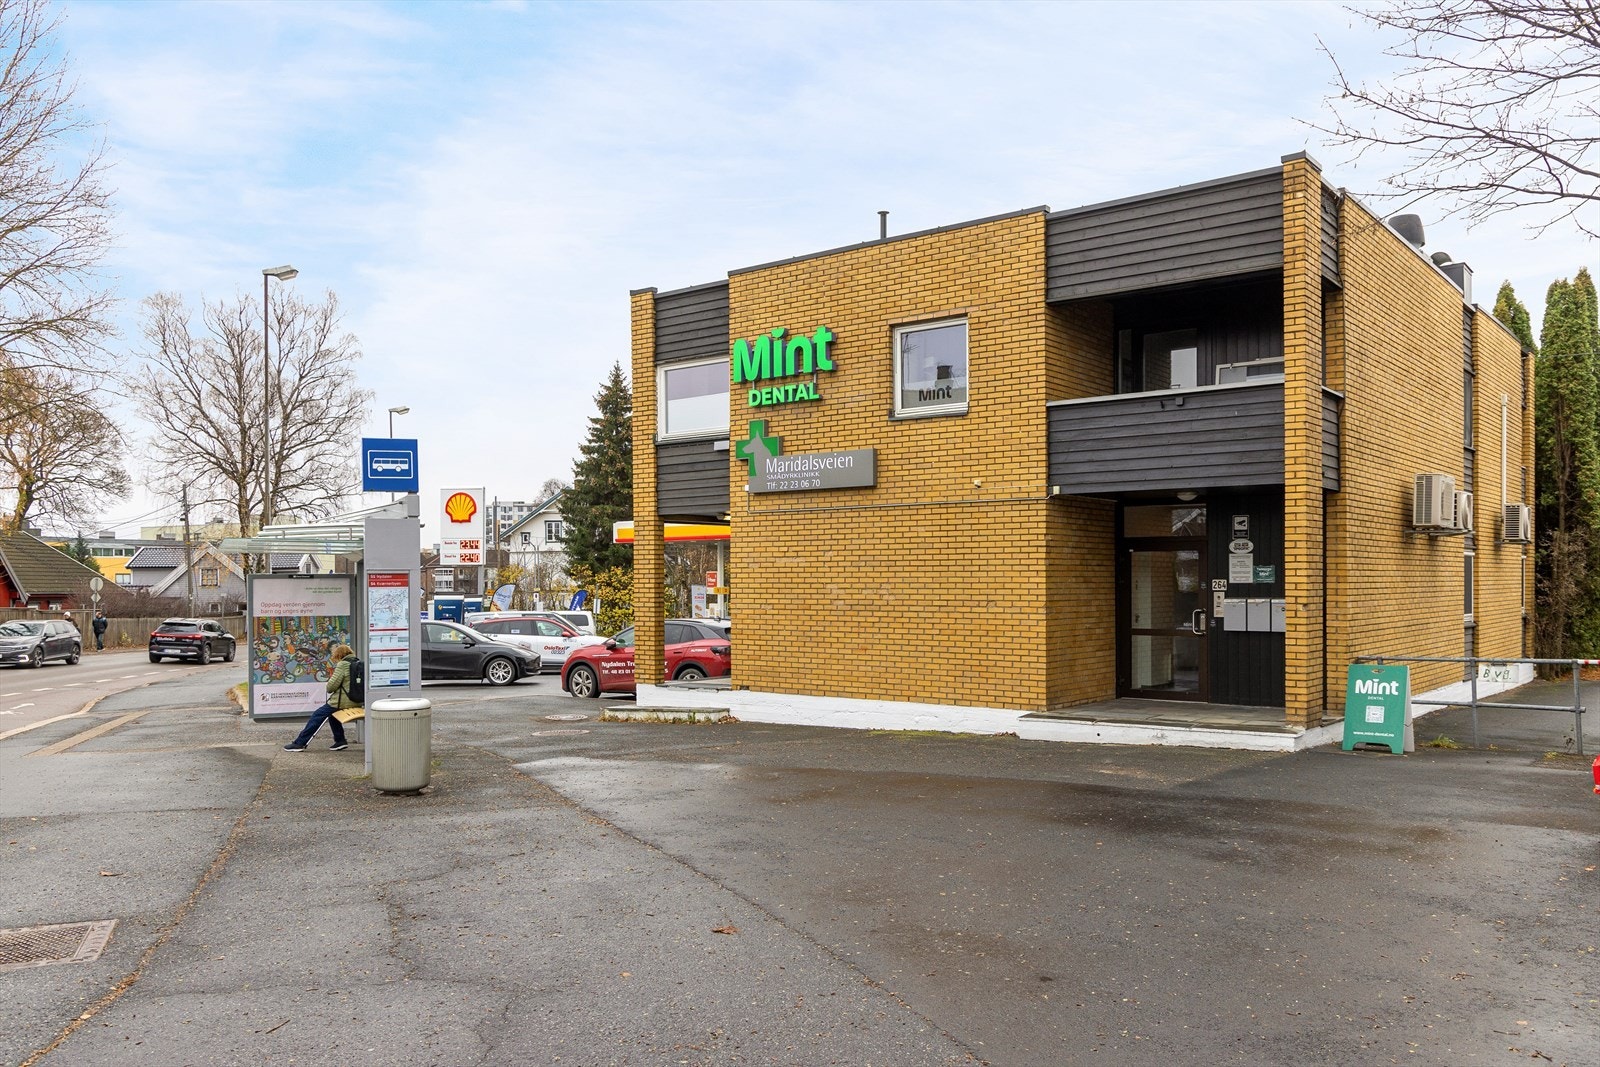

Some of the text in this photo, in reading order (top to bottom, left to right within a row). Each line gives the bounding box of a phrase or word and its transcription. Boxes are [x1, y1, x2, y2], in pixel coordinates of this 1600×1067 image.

[733, 325, 836, 383] Mint
[748, 381, 822, 407] DENTAL
[918, 385, 952, 402] Mint
[766, 453, 853, 473] Maridalsveien
[766, 471, 820, 479] SMÅDYRKLINIKK
[766, 479, 821, 490] Tlf: 22 23 06 70
[1213, 580, 1226, 589] 264
[1355, 678, 1399, 695] Mint
